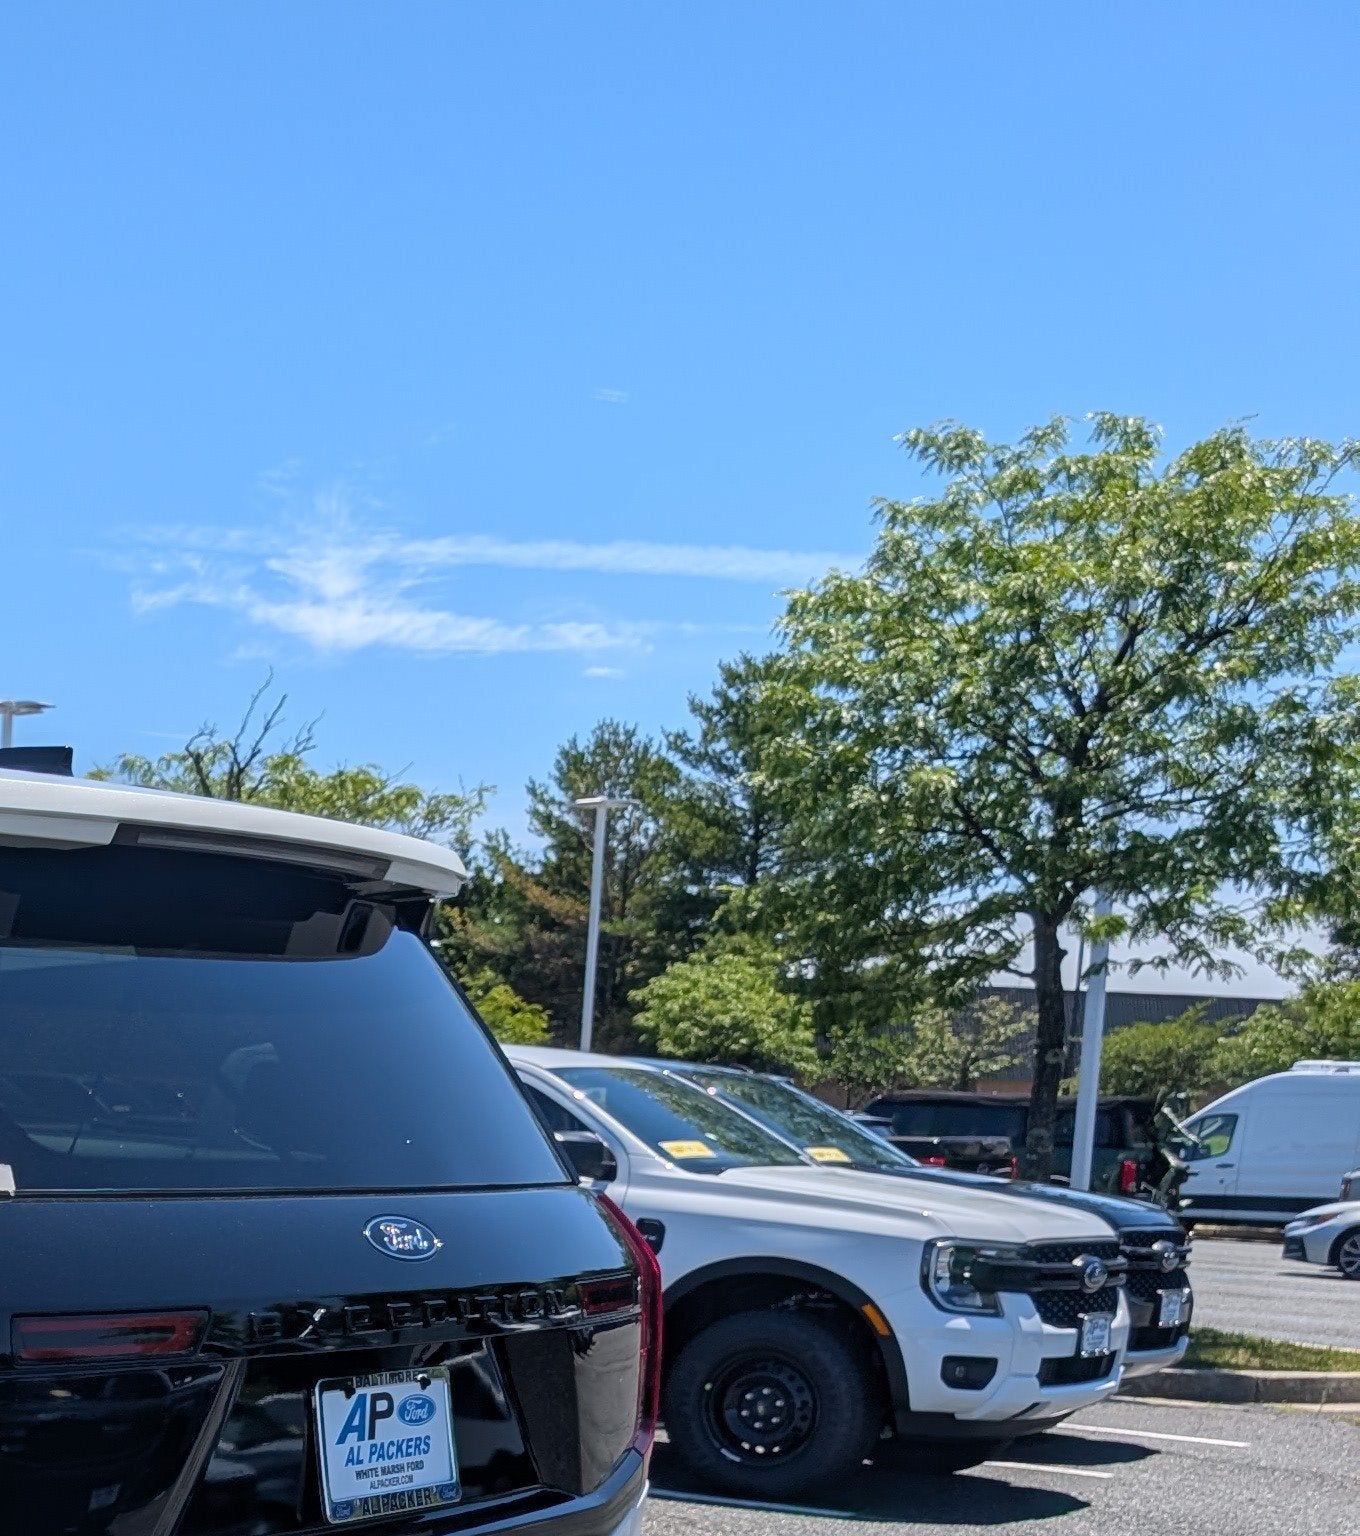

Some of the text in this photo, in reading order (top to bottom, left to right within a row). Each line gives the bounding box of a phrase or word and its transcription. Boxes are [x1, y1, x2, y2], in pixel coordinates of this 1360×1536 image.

[380, 1222, 429, 1251] Ford
[335, 1392, 395, 1446] AP
[404, 1398, 429, 1421] Ford
[344, 1435, 432, 1467] AL PACKERS
[355, 1459, 425, 1481] WHITE MARSH FORD
[369, 1474, 414, 1490] ALPACKER.COM
